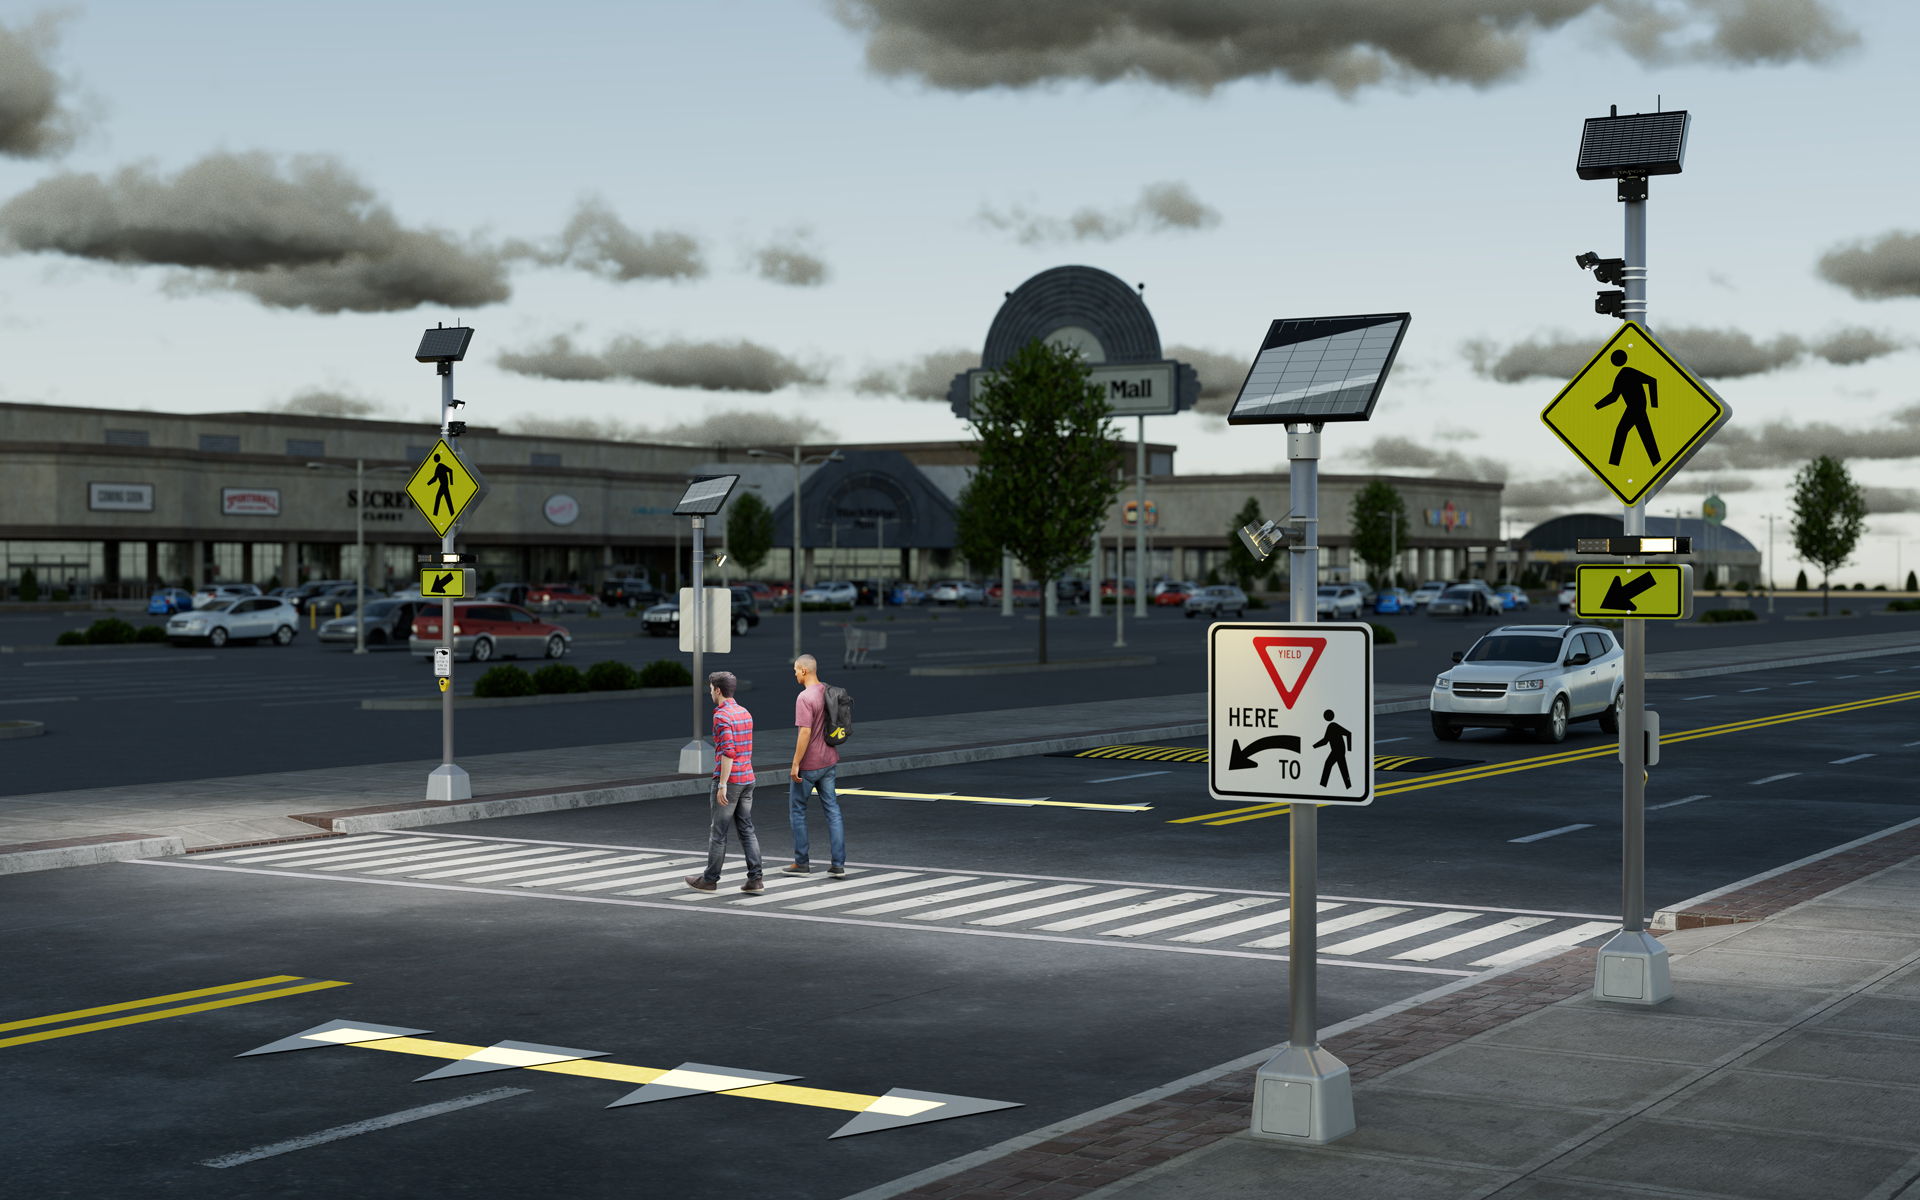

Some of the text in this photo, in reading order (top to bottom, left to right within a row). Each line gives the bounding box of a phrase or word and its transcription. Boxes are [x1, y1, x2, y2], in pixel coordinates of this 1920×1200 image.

[1110, 378, 1152, 399] Mall
[1278, 649, 1302, 659] YIELD
[1229, 707, 1279, 728] HERE
[1279, 759, 1301, 780] TO
